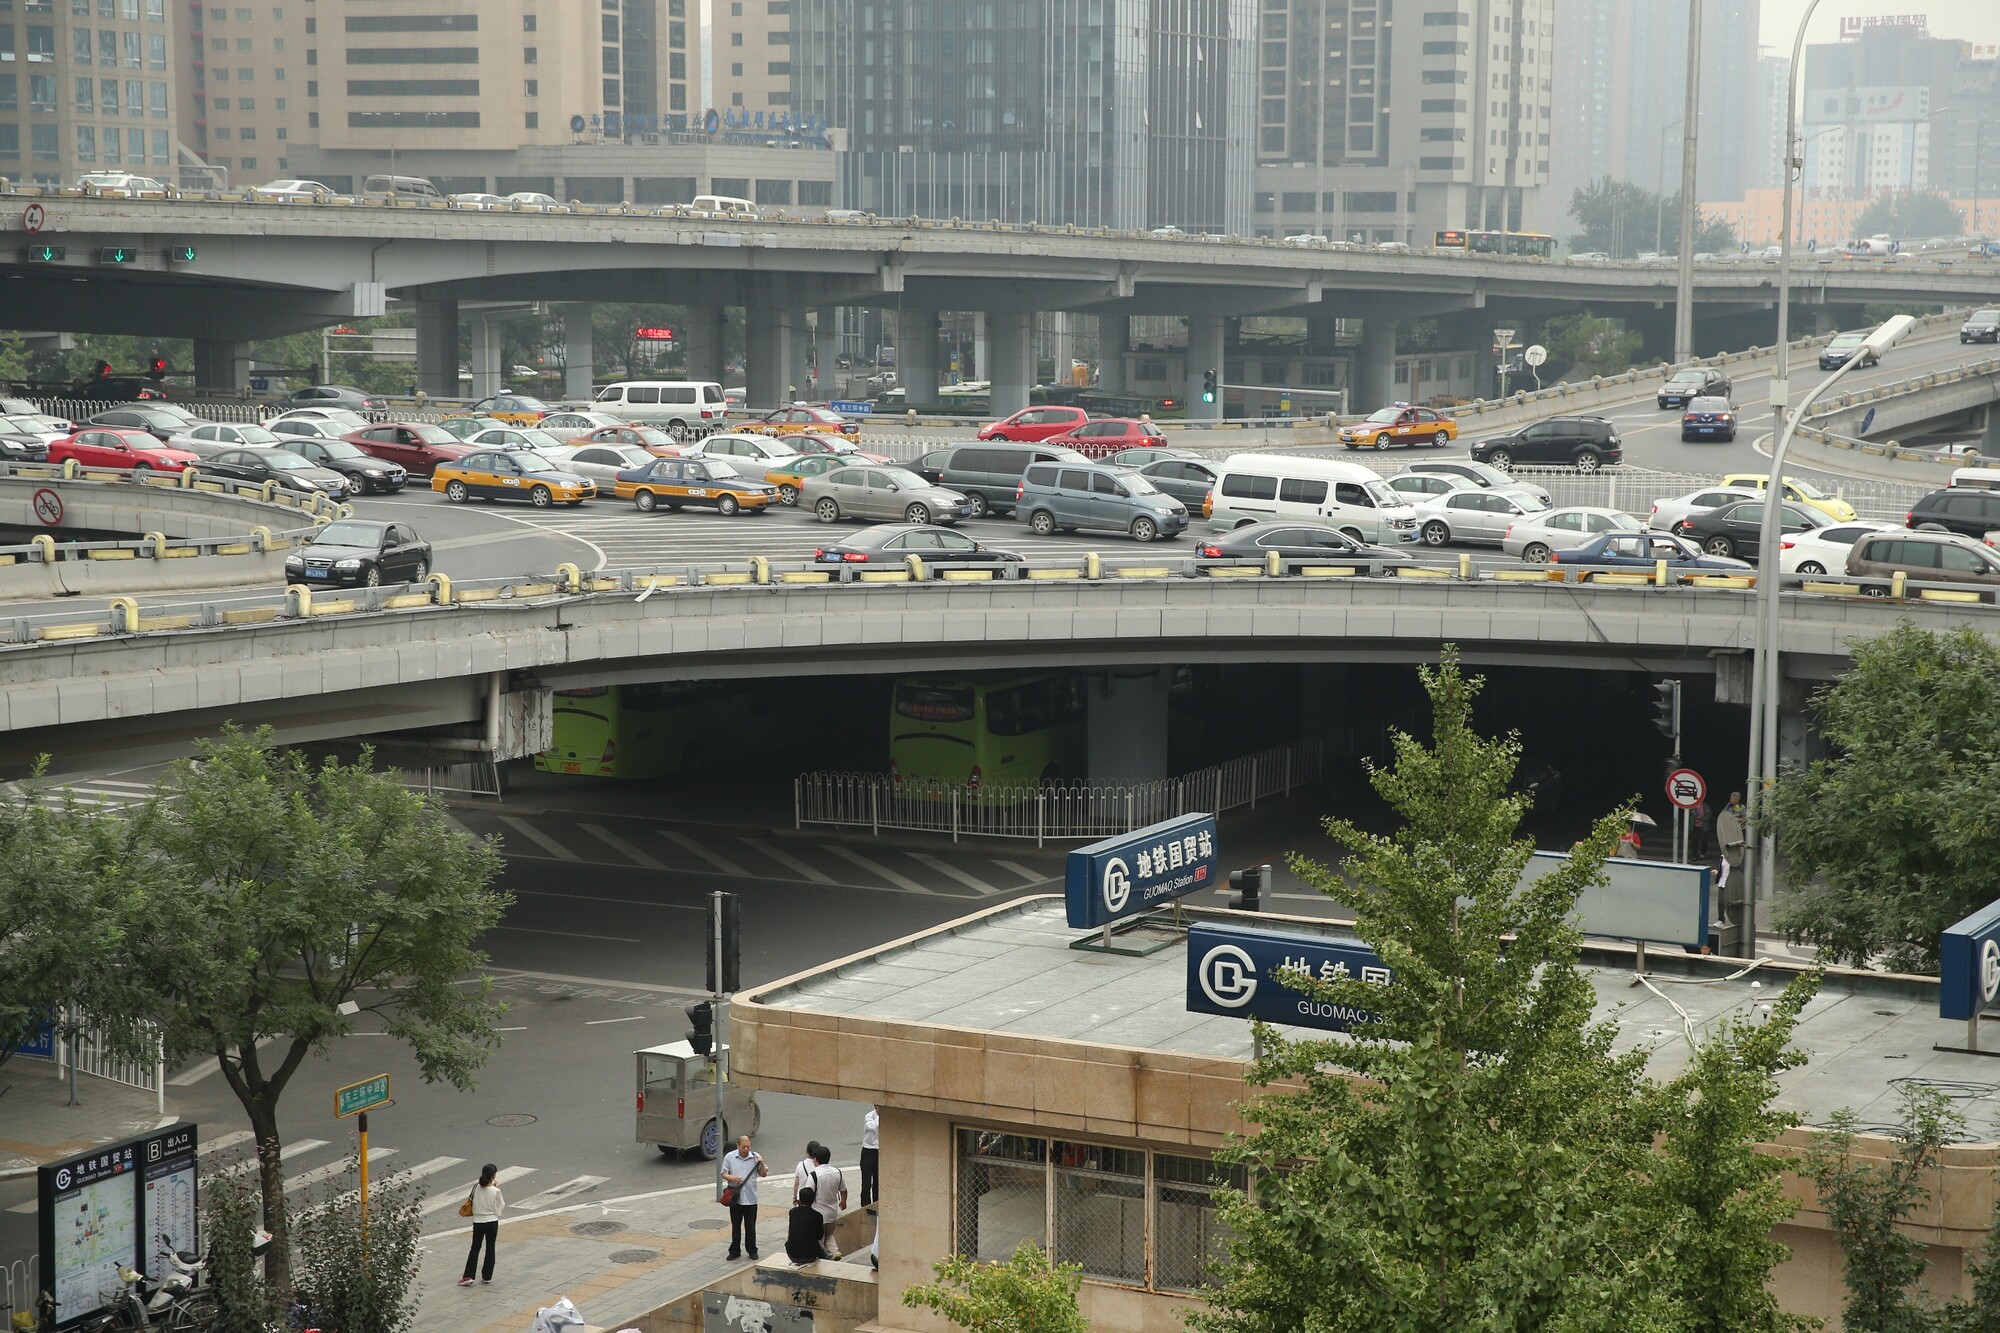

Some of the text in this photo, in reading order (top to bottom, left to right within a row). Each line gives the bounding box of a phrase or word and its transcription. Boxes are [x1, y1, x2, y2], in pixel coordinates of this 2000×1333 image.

[841, 404, 870, 413] 东三环中路
[1137, 830, 1212, 879] 地铁国贸站
[1143, 874, 1194, 900] GUOMAO Station
[1281, 956, 1391, 987] 地铁国
[1297, 1000, 1369, 1023] GUOMAO
[150, 1143, 160, 1159] B
[167, 1133, 188, 1148] 出入口
[76, 1148, 133, 1175] 地铁国贸站
